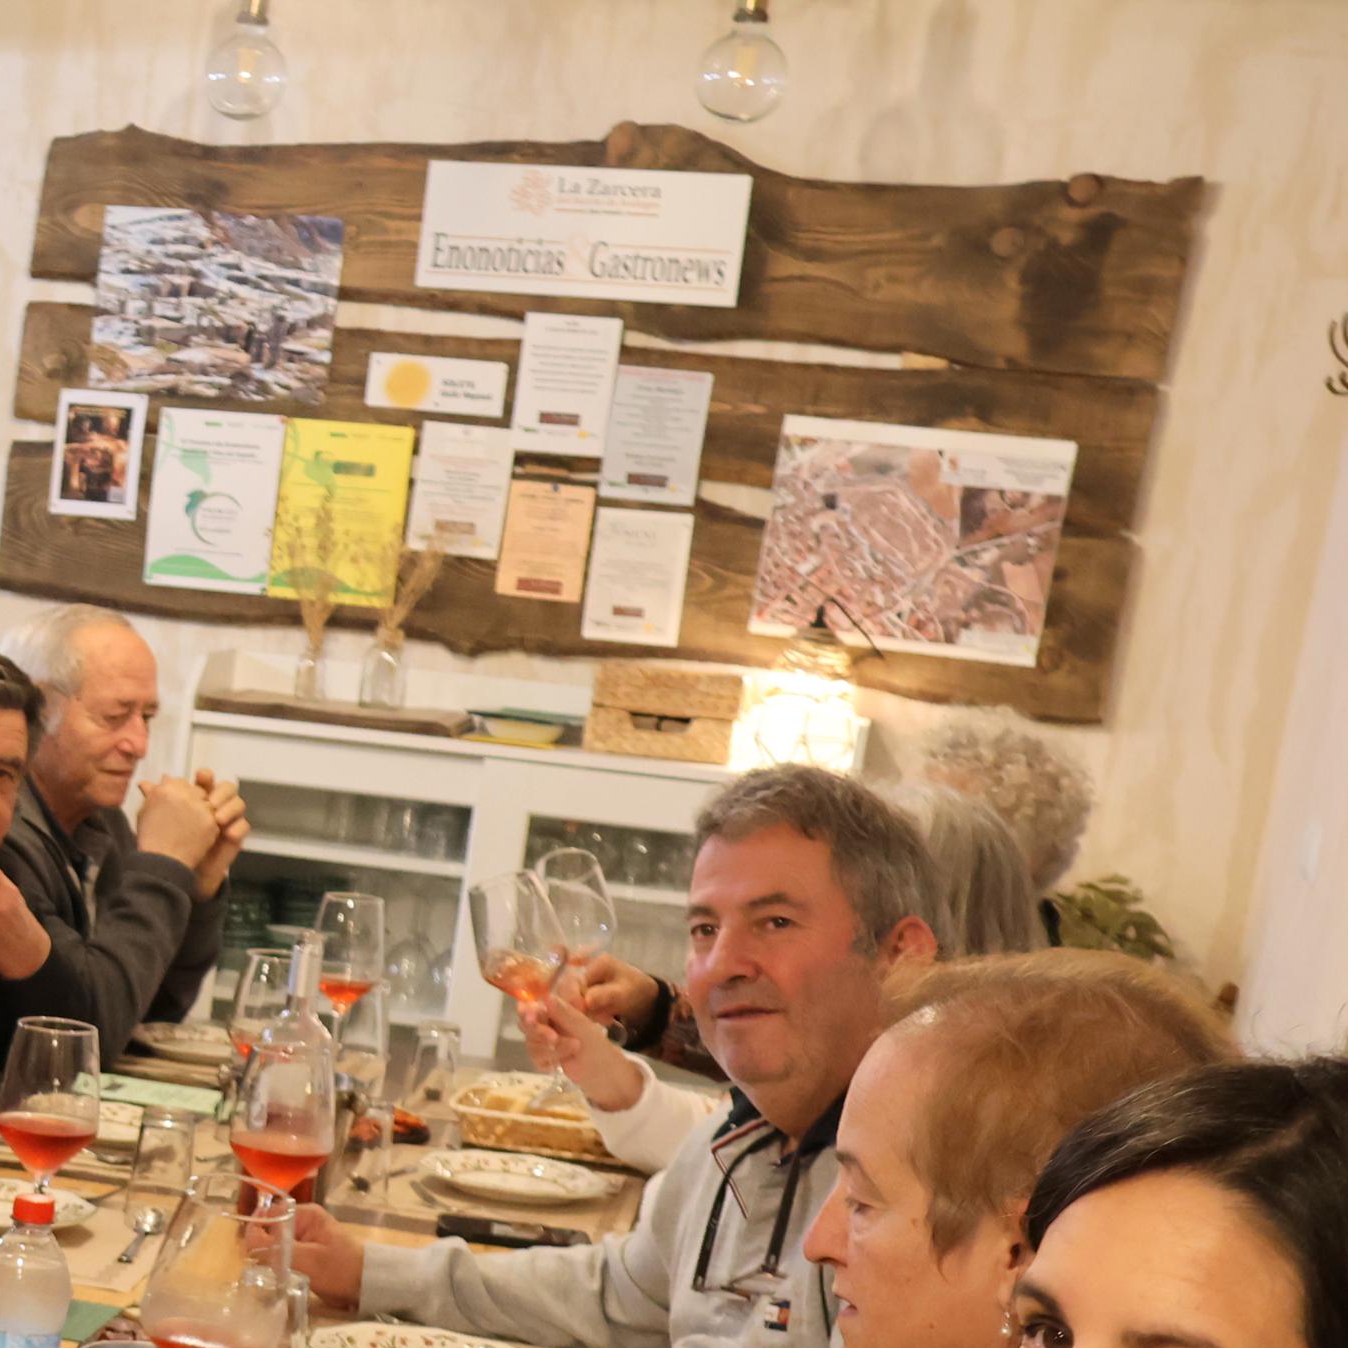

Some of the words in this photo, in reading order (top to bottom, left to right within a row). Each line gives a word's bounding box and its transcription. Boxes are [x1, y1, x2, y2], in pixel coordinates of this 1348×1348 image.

[557, 176, 581, 196] La
[586, 178, 662, 199] Zarcera
[431, 231, 566, 277] Enonoticias
[588, 241, 727, 286] Gastronews
